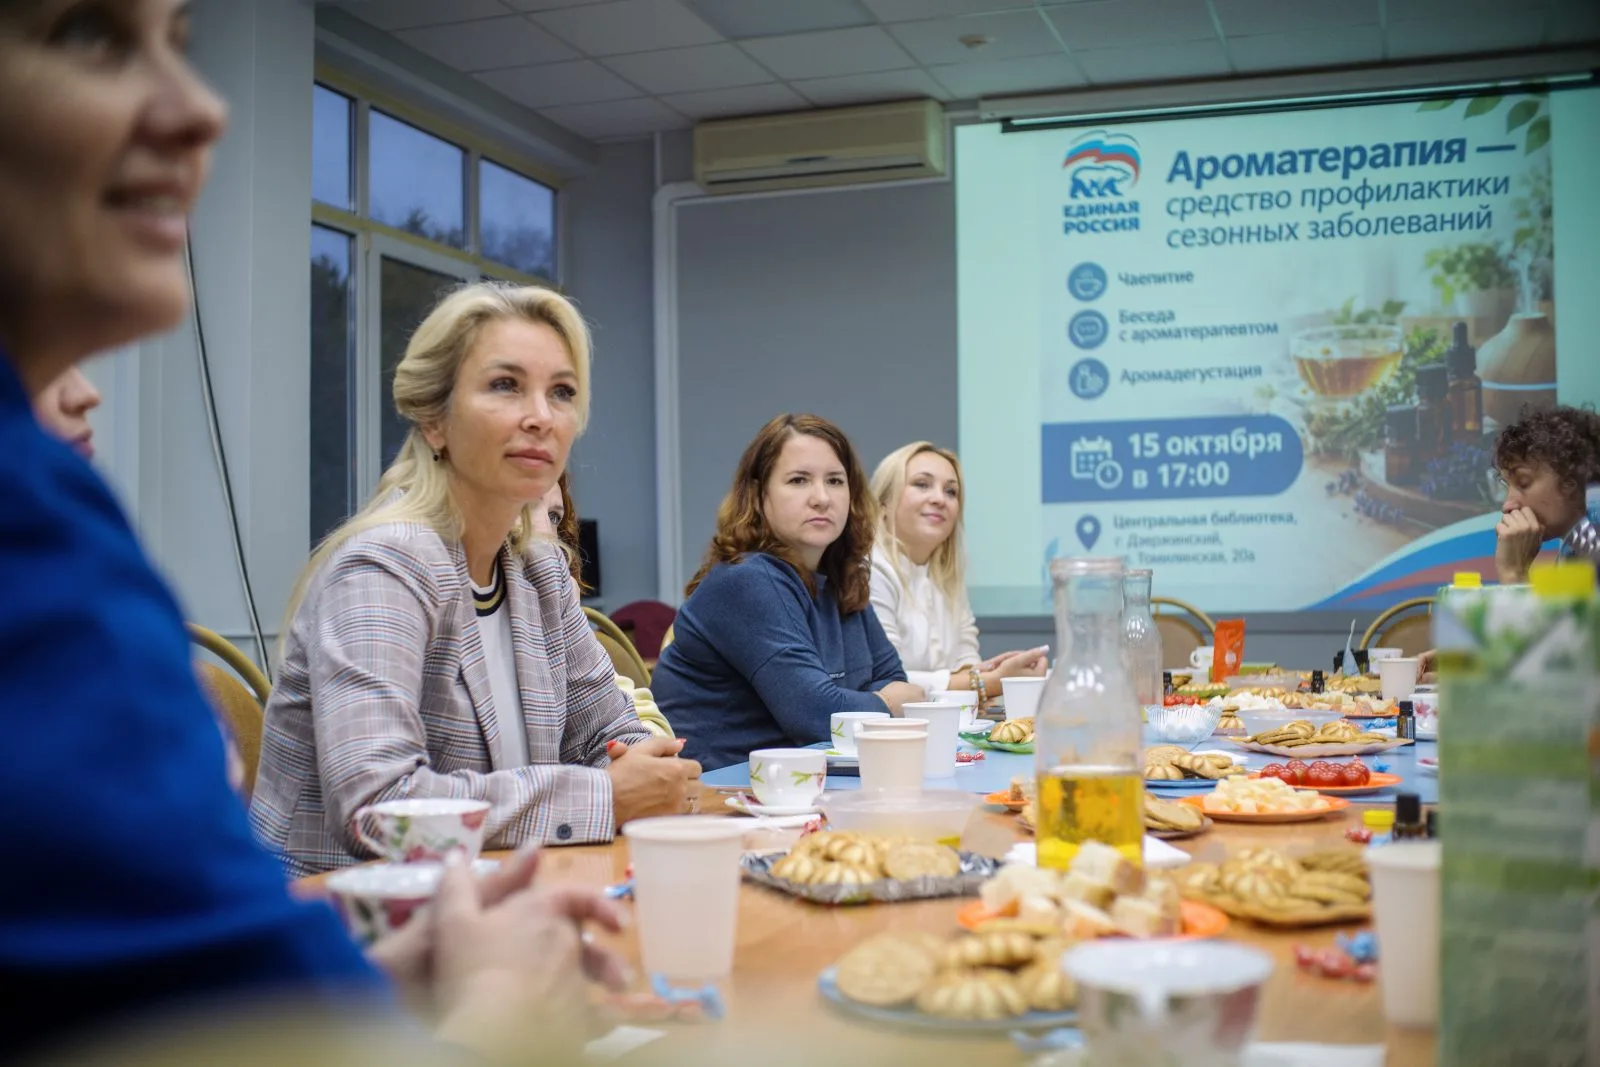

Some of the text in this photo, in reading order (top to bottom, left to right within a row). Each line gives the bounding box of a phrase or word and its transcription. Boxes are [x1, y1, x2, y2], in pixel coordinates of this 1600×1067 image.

[1166, 137, 1467, 190] Ароматерапия
[1166, 176, 1510, 221] средство профилактики
[1062, 201, 1140, 219] ЕДИНАЯ
[1063, 217, 1140, 235] РОССИЯ
[1166, 204, 1493, 248] сезонных заболеваний
[1118, 269, 1194, 287] Чаепитие
[1119, 309, 1175, 325] Беседа
[1119, 322, 1279, 344] с ароматерапевтом
[1120, 364, 1263, 386] Аромадегустация
[1128, 427, 1282, 460] 15 октября
[1132, 460, 1230, 489] в 17:00
